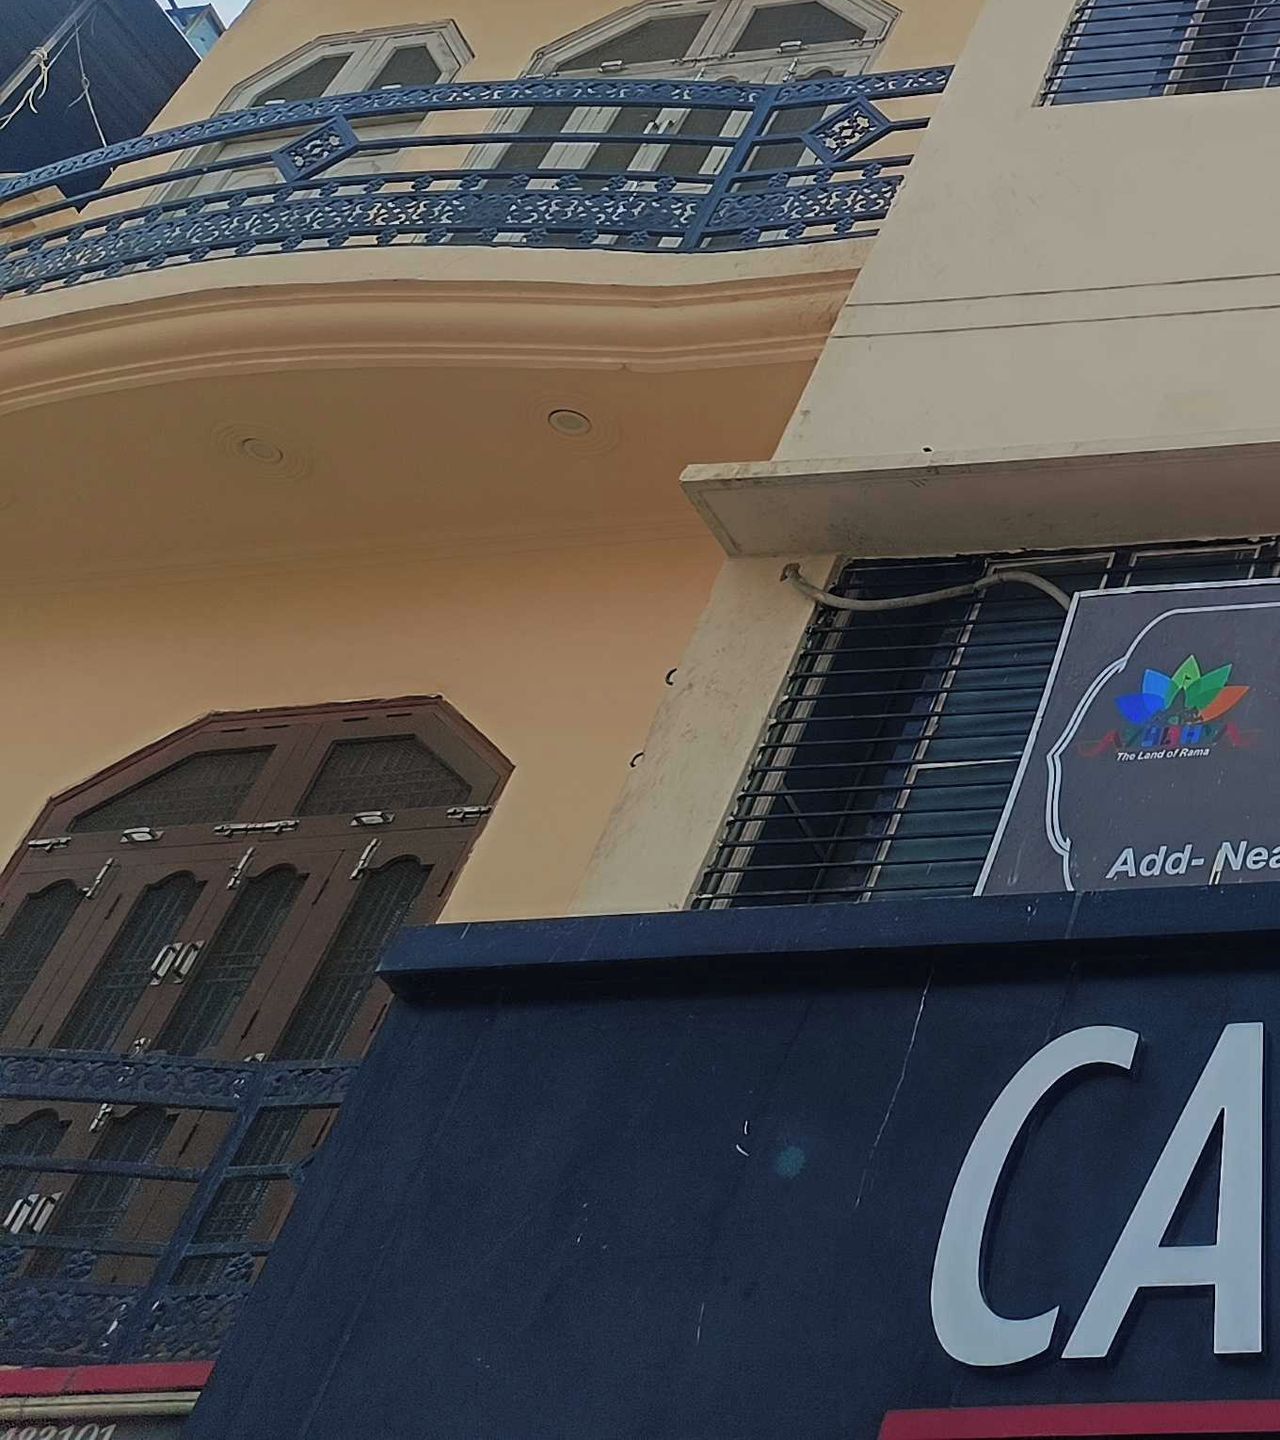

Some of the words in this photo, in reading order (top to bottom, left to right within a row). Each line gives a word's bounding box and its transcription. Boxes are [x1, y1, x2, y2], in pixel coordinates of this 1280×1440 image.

[1116, 752, 1136, 761] The
[1137, 748, 1165, 760] Land
[1166, 748, 1180, 758] of
[1179, 747, 1210, 758] Rama
[1106, 846, 1205, 880] Add-
